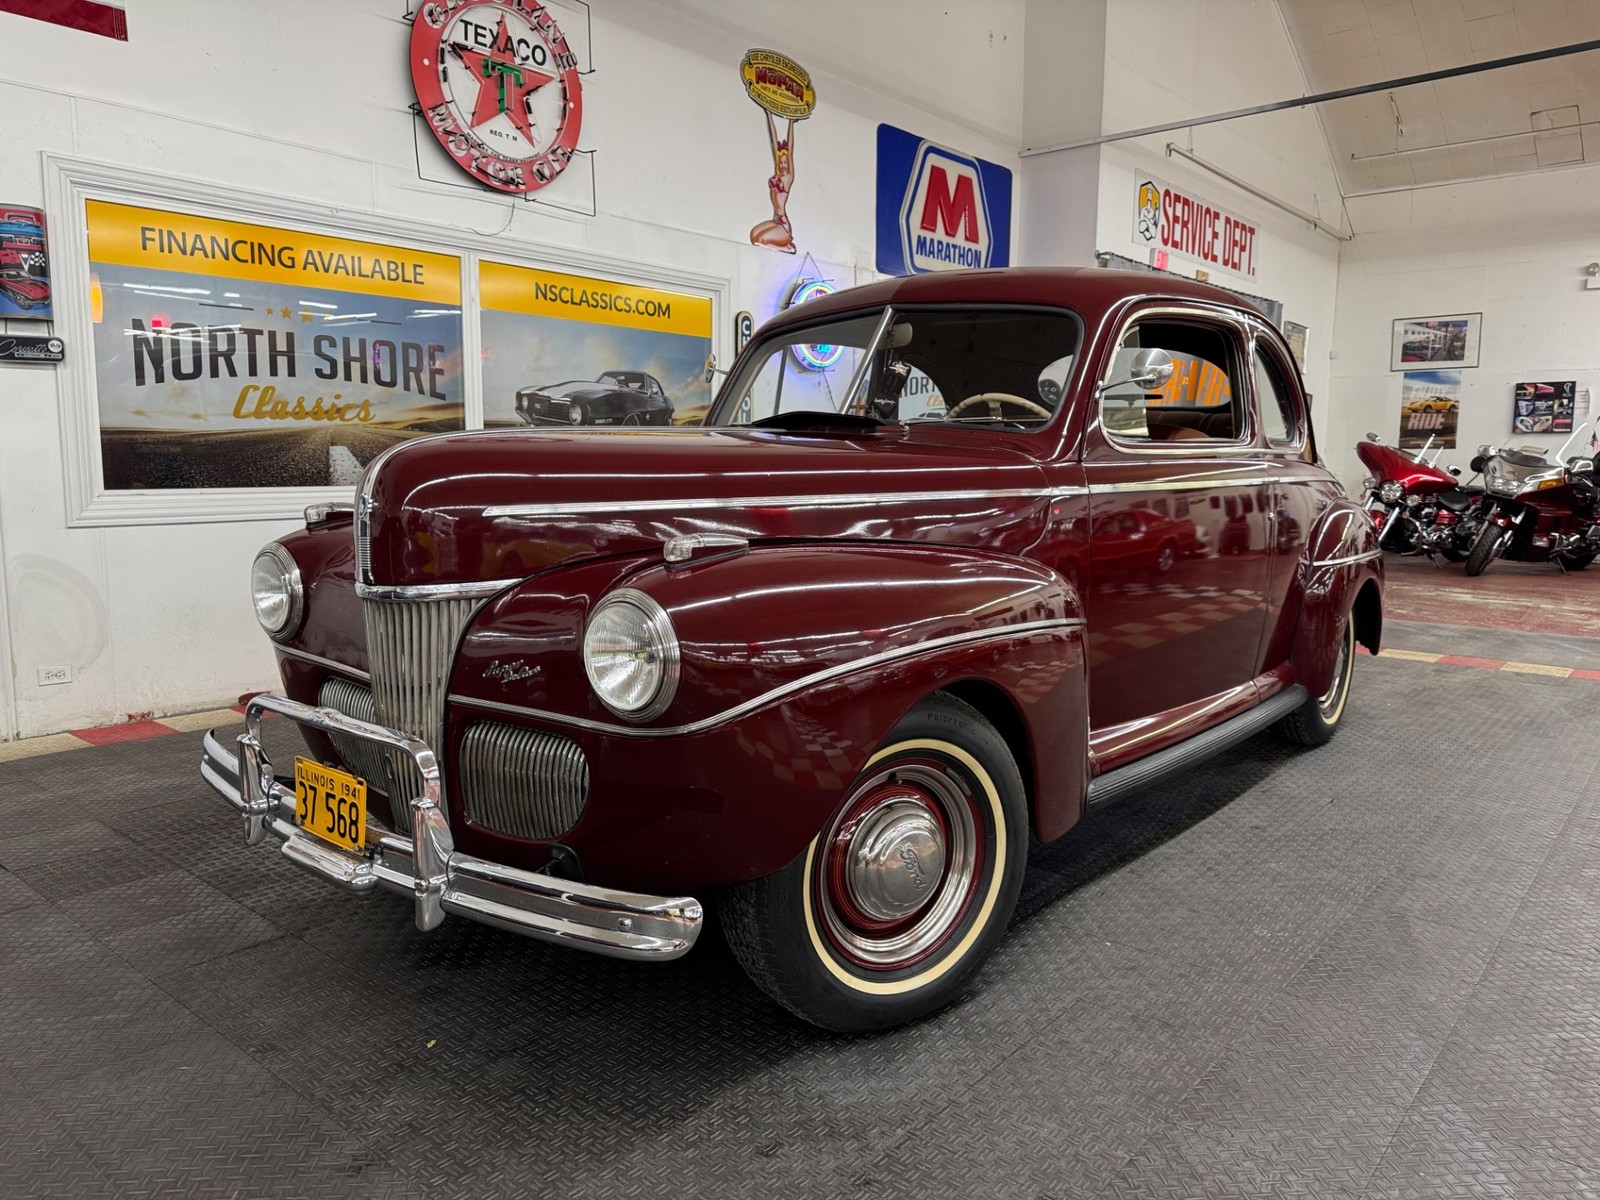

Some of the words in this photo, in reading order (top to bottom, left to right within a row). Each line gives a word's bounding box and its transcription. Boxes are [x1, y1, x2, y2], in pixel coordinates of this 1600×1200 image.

[459, 19, 547, 66] TEXACO
[482, 58, 523, 114] T
[428, 102, 526, 189] MOTOR
[140, 226, 296, 269] FINANCING
[302, 249, 425, 285] AVAILABLE
[916, 235, 981, 268] MARATHON
[1161, 189, 1221, 264] SERVICE
[1222, 215, 1256, 277] DEPT.
[534, 282, 671, 319] NSCLASSICS.COM
[131, 317, 297, 387] NORTH
[313, 334, 447, 401] SHORE
[232, 385, 376, 423] Classics
[1407, 412, 1446, 430] RIDE
[297, 766, 335, 791] ILLINOIS
[341, 782, 361, 801] 1941
[299, 780, 318, 825] 37
[325, 791, 359, 844] 568
[900, 844, 928, 890] Ford
